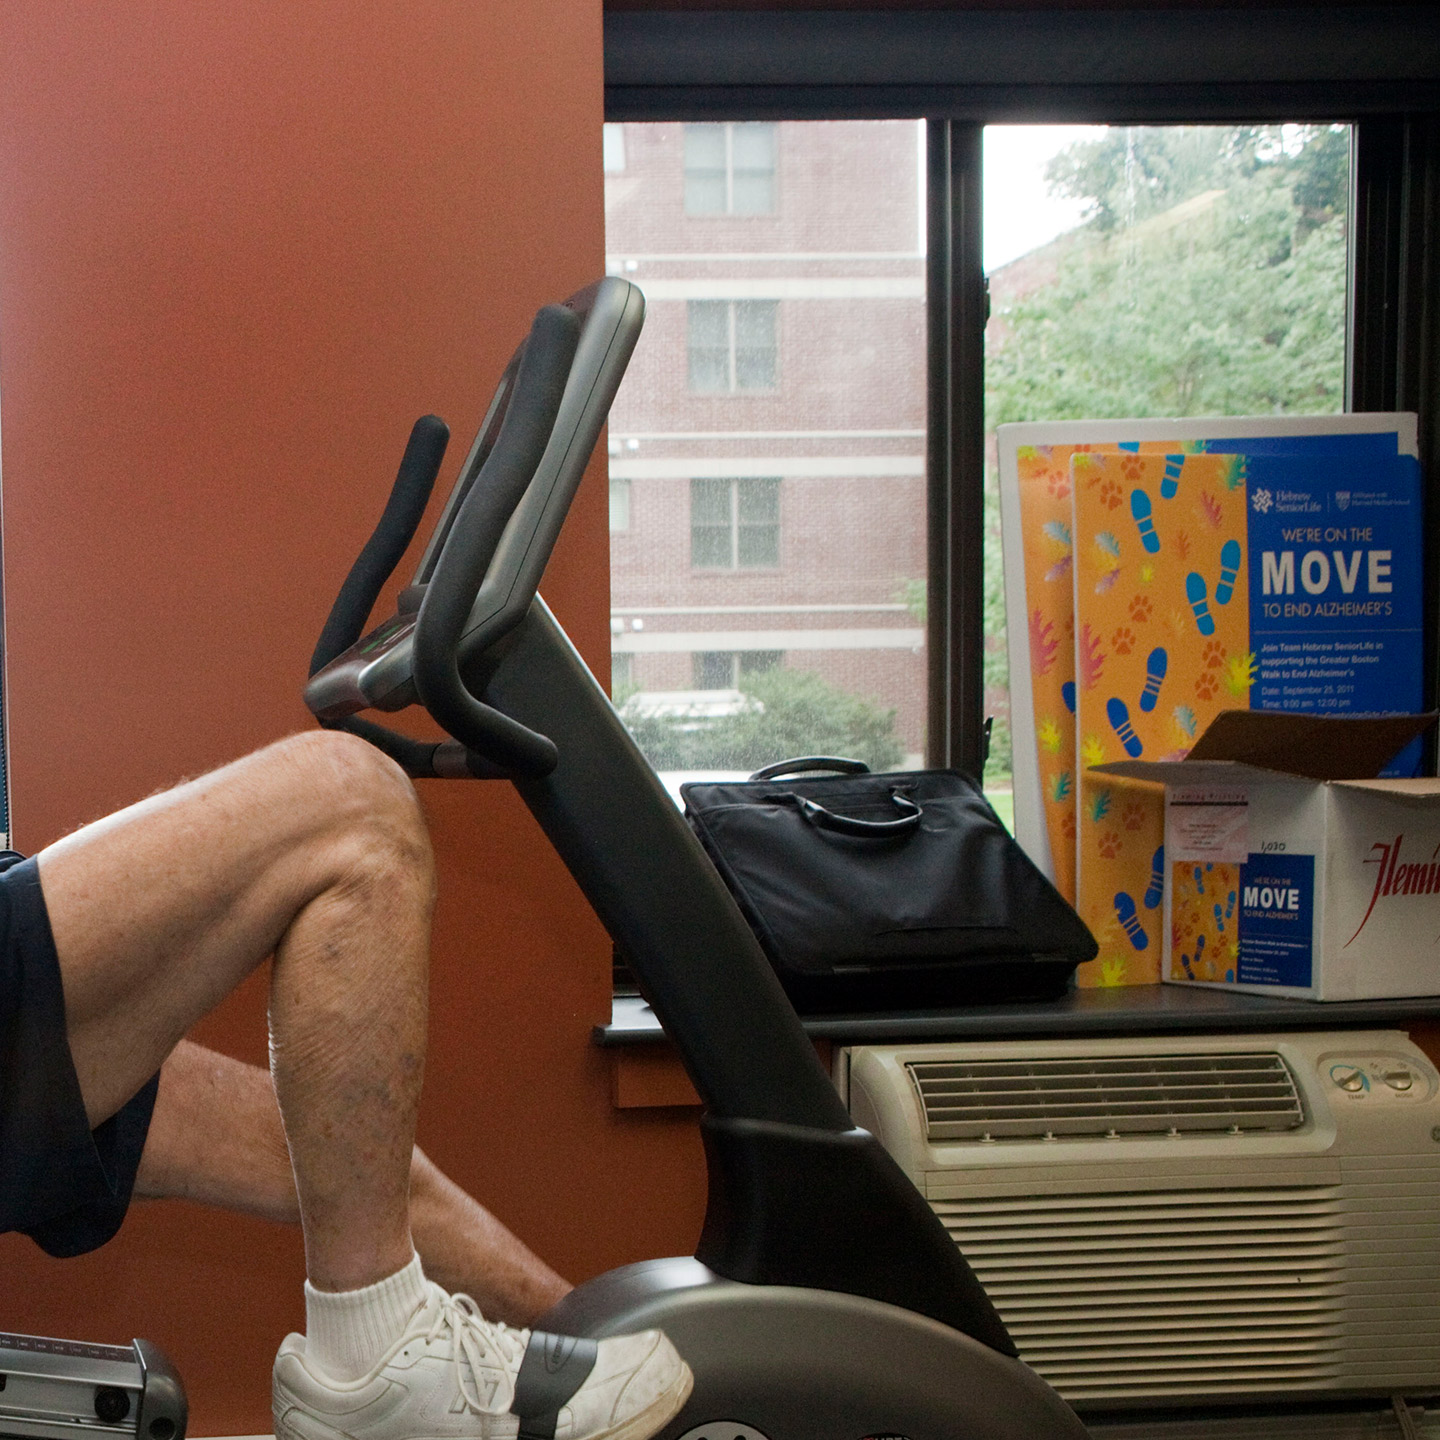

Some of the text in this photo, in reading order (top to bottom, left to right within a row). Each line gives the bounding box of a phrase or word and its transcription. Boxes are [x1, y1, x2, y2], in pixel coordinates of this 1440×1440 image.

[1276, 490, 1311, 501] Hebrew
[1275, 502, 1322, 512] SeniorLife
[1282, 527, 1373, 542] WE'RE ON THE
[1262, 550, 1393, 595] MOVE
[1263, 601, 1393, 618] TO END ALZHEIMER'S
[1261, 641, 1384, 653] Join Team Hebrew SeniorLife in
[1261, 655, 1379, 667] supporting the Greater Boston
[1261, 669, 1355, 679] Walk to End Alzheimer's
[1282, 686, 1322, 696] September
[1337, 685, 1354, 694] 2011
[1317, 698, 1338, 708] 12:00
[1338, 699, 1351, 709] pm
[1243, 886, 1300, 910] MOVE
